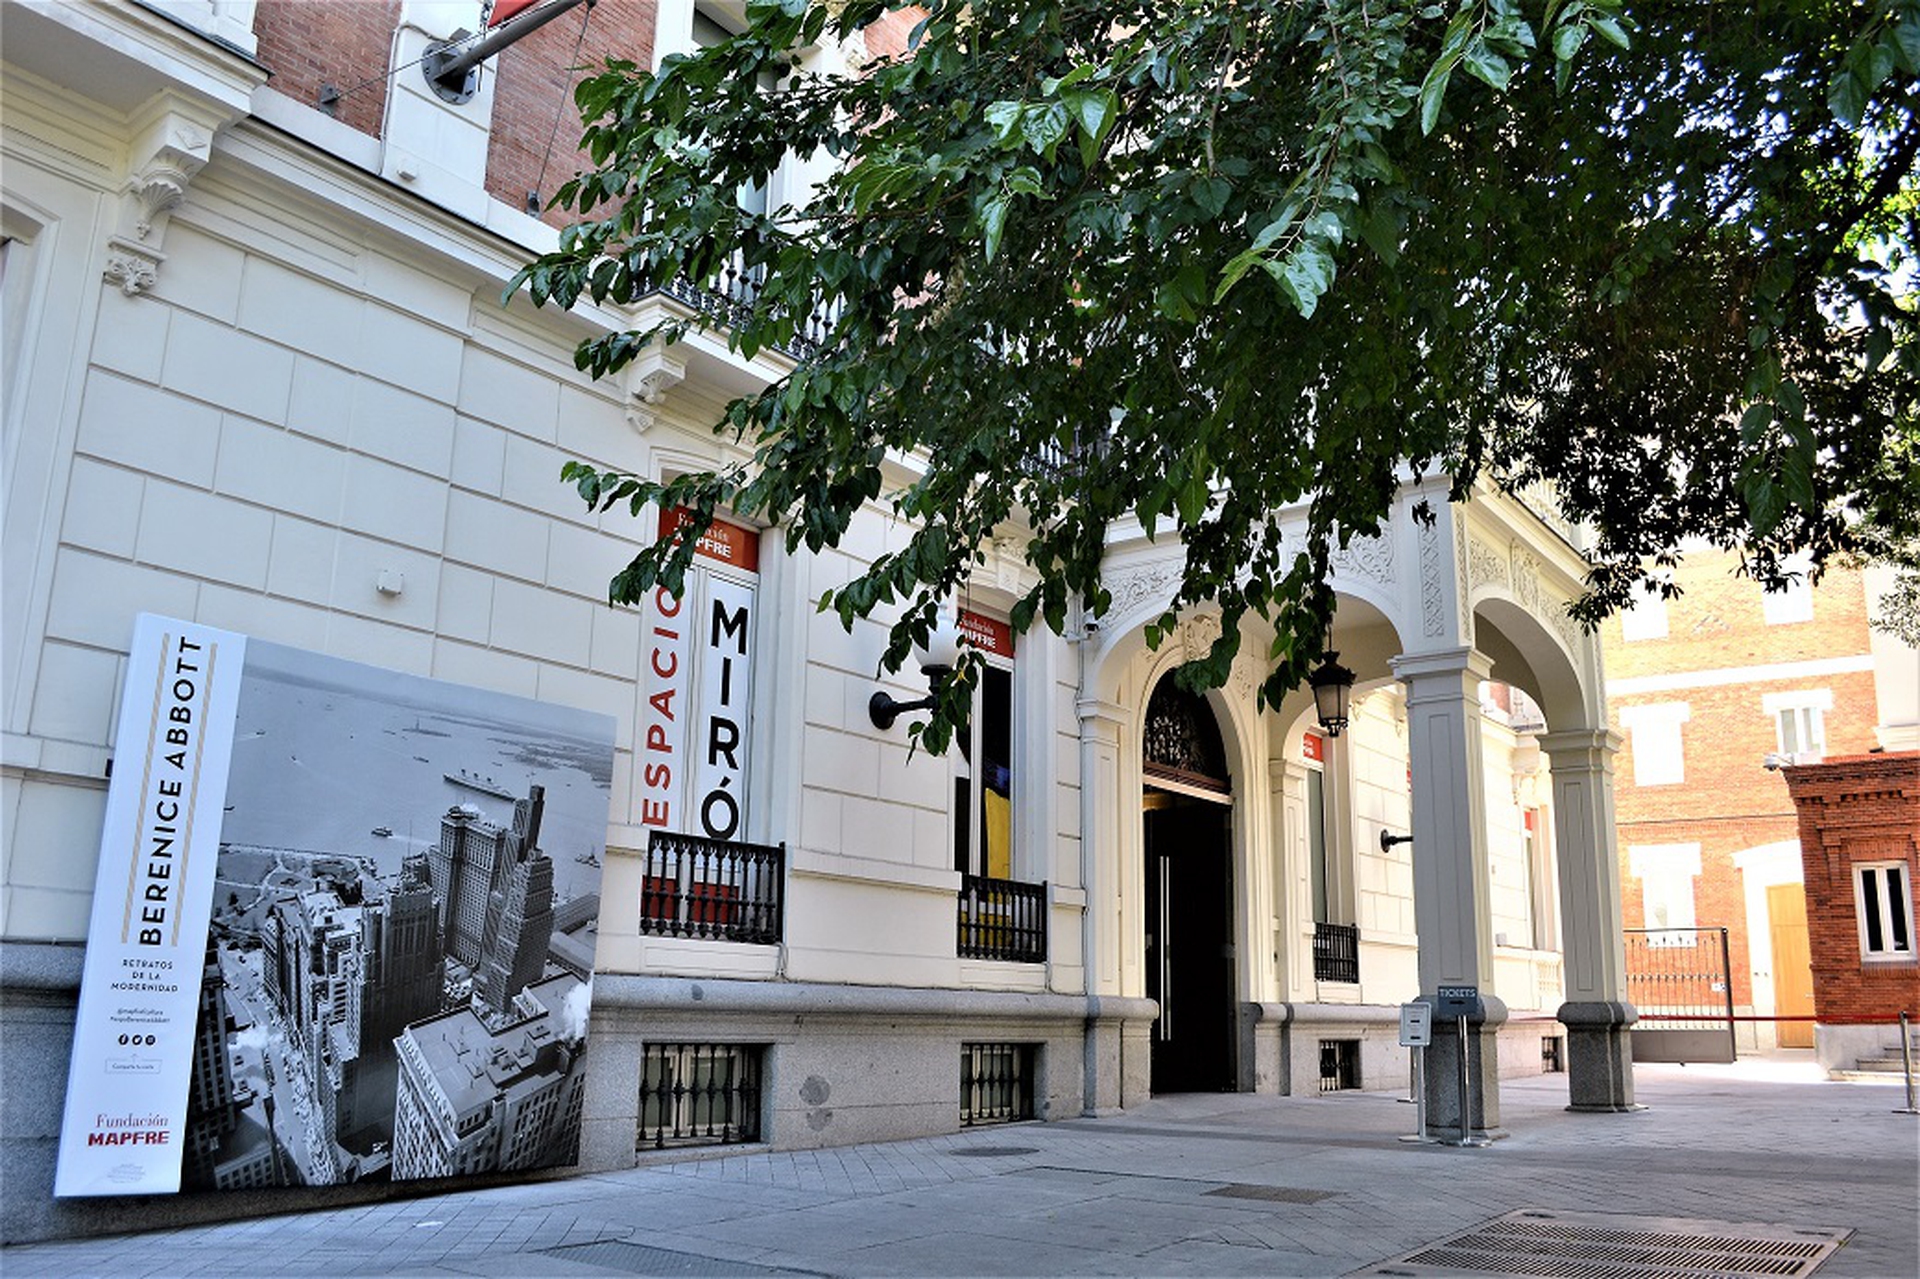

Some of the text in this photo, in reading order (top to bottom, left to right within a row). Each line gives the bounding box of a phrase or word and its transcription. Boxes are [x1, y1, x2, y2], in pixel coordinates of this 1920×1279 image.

[642, 585, 681, 827] ESPACIO
[701, 599, 748, 840] MIRÓ
[139, 636, 201, 945] BERENICE ABBOTT
[122, 959, 173, 970] RETRATOS
[132, 971, 161, 981] DE LA
[110, 982, 178, 992] MODERNIDAD
[1439, 988, 1476, 998] TICKETS
[96, 1112, 169, 1128] Fundación
[88, 1130, 170, 1146] MAPFRE
